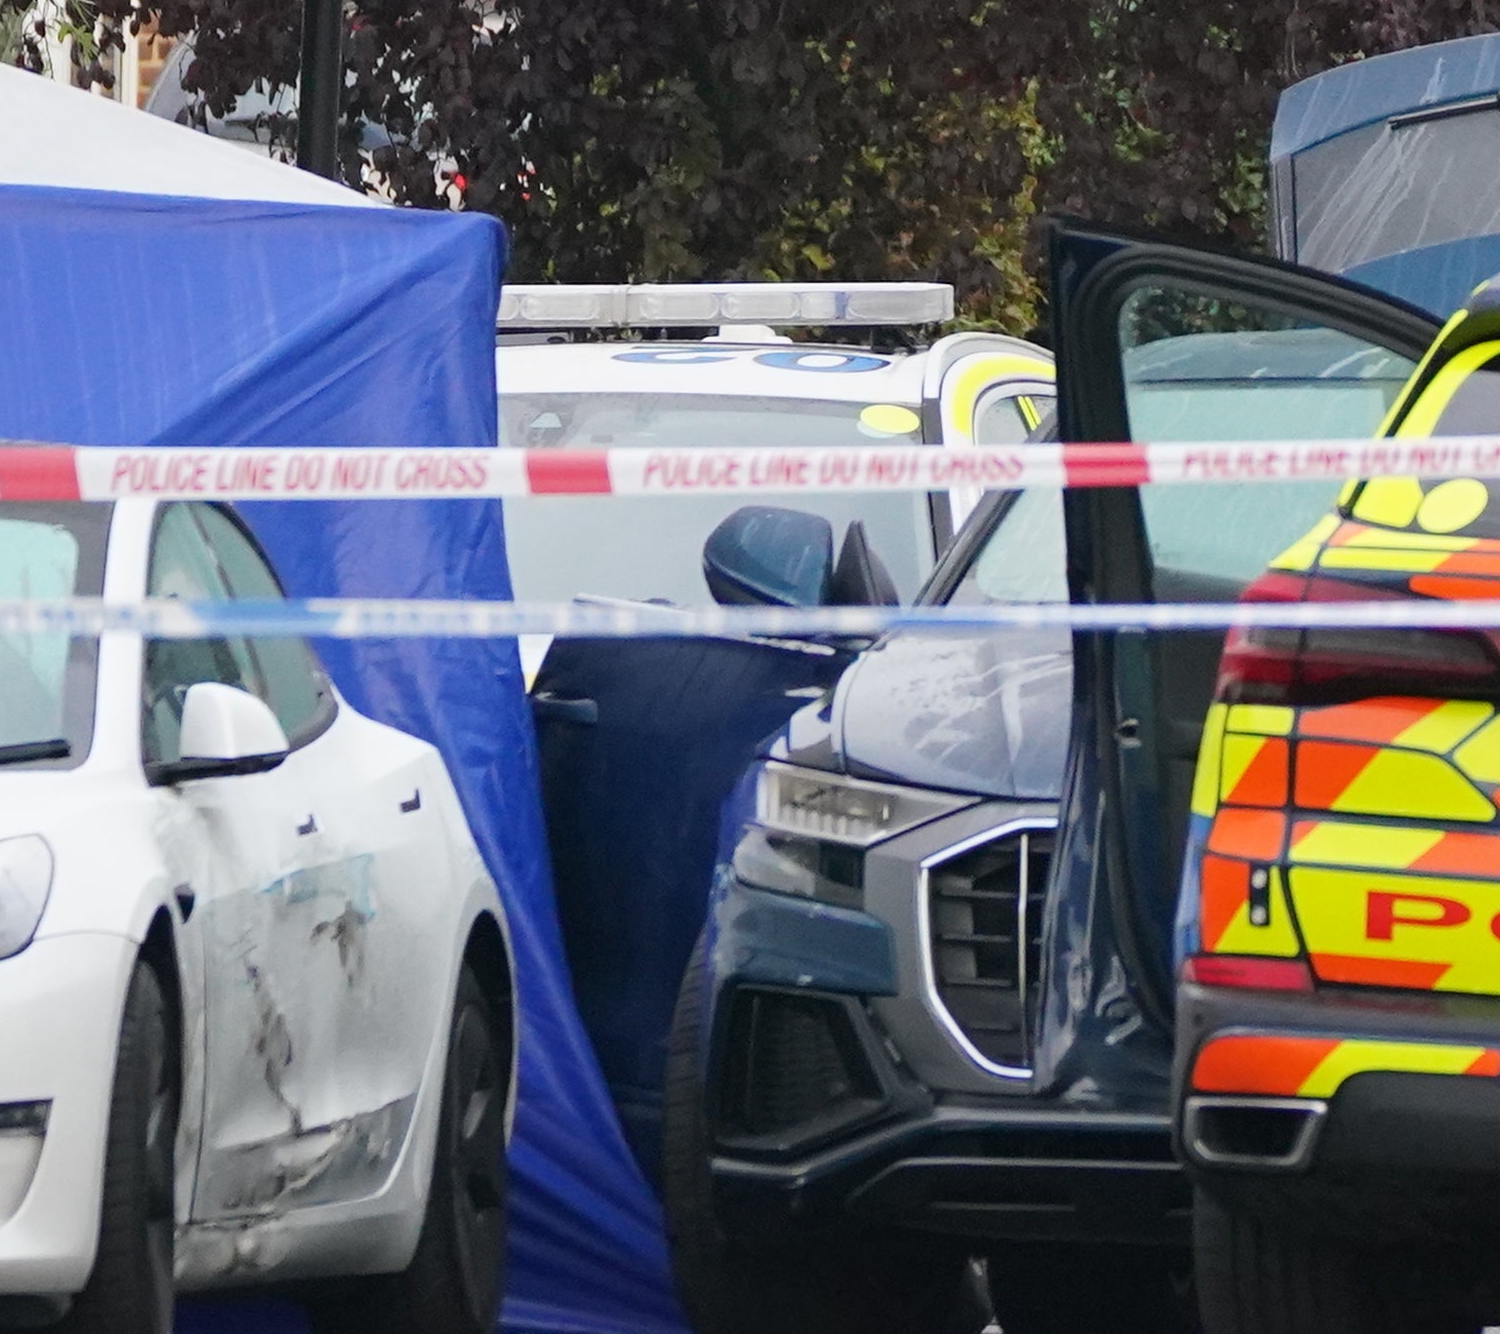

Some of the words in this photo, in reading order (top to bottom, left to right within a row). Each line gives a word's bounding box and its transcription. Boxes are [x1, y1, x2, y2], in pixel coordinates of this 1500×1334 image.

[111, 454, 209, 492] POLICE
[215, 454, 279, 492] LINE
[285, 453, 327, 491] DO
[330, 453, 391, 490] NOT
[395, 452, 490, 490] CROSS
[642, 452, 740, 488] POLICE
[749, 452, 809, 487] LINE
[818, 452, 858, 486] DO
[866, 452, 918, 485] NOT
[929, 451, 1024, 483] CROSS
